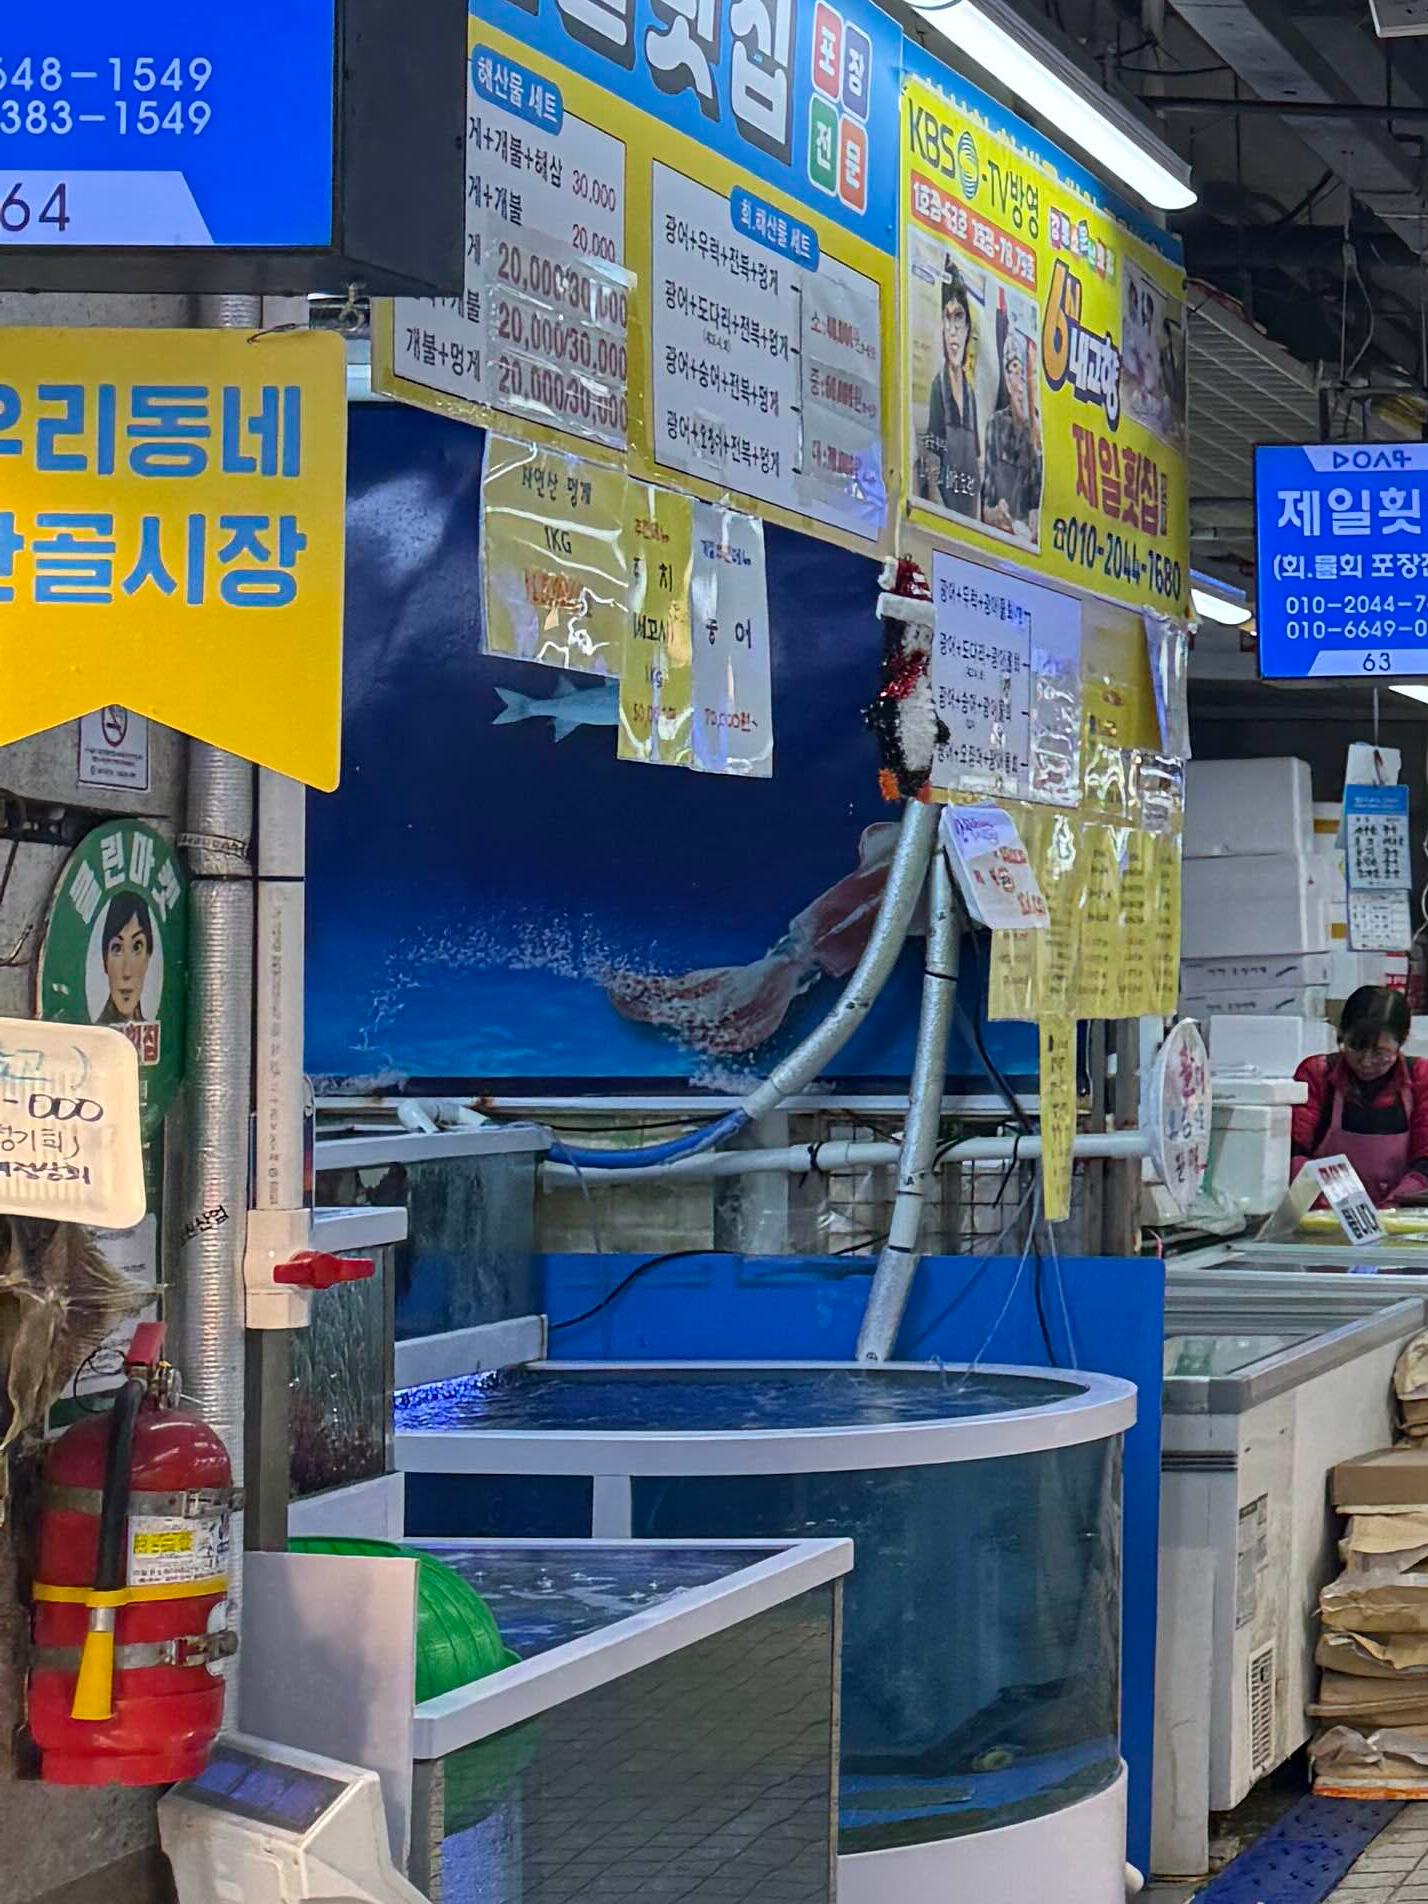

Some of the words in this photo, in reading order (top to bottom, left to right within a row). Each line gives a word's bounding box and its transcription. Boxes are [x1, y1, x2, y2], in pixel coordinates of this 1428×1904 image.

[469, 116, 564, 189] 게+개불+해삼
[909, 98, 955, 179] KBS
[0, 183, 70, 233] 64
[469, 175, 523, 227] 게+개불
[0, 383, 301, 477] 리동네
[0, 512, 307, 608] 골시장
[1363, 652, 1392, 672] 63
